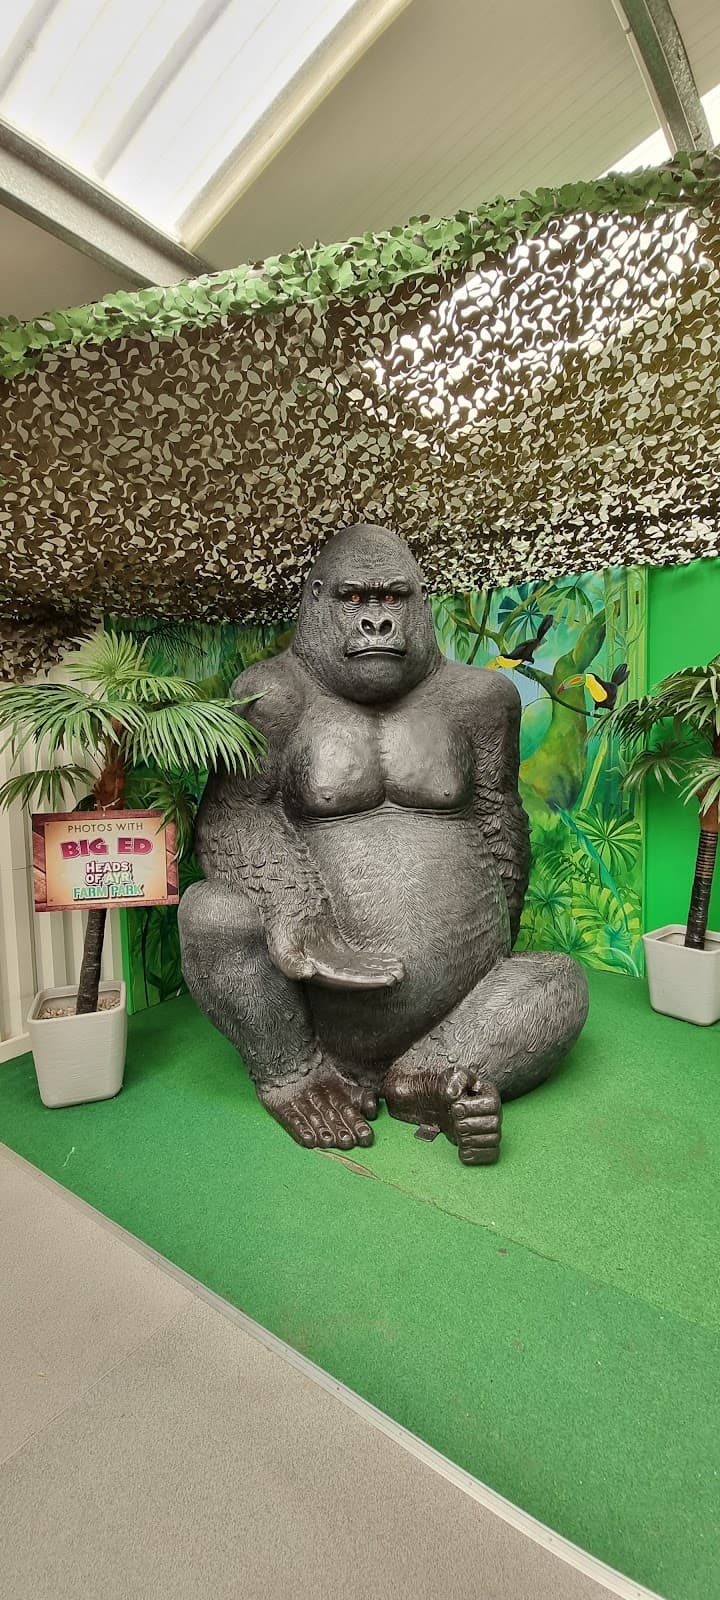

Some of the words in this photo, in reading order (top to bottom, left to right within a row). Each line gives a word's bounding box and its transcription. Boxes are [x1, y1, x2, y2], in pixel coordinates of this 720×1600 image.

[68, 823, 113, 833] PHOTOS
[116, 822, 143, 831] WITH
[61, 837, 109, 859] BIG
[117, 837, 153, 855] ED
[86, 860, 131, 873] HEADS
[85, 873, 103, 885] OF
[104, 872, 132, 884] AYR
[73, 885, 107, 900] FARM
[111, 884, 143, 898] PARK
